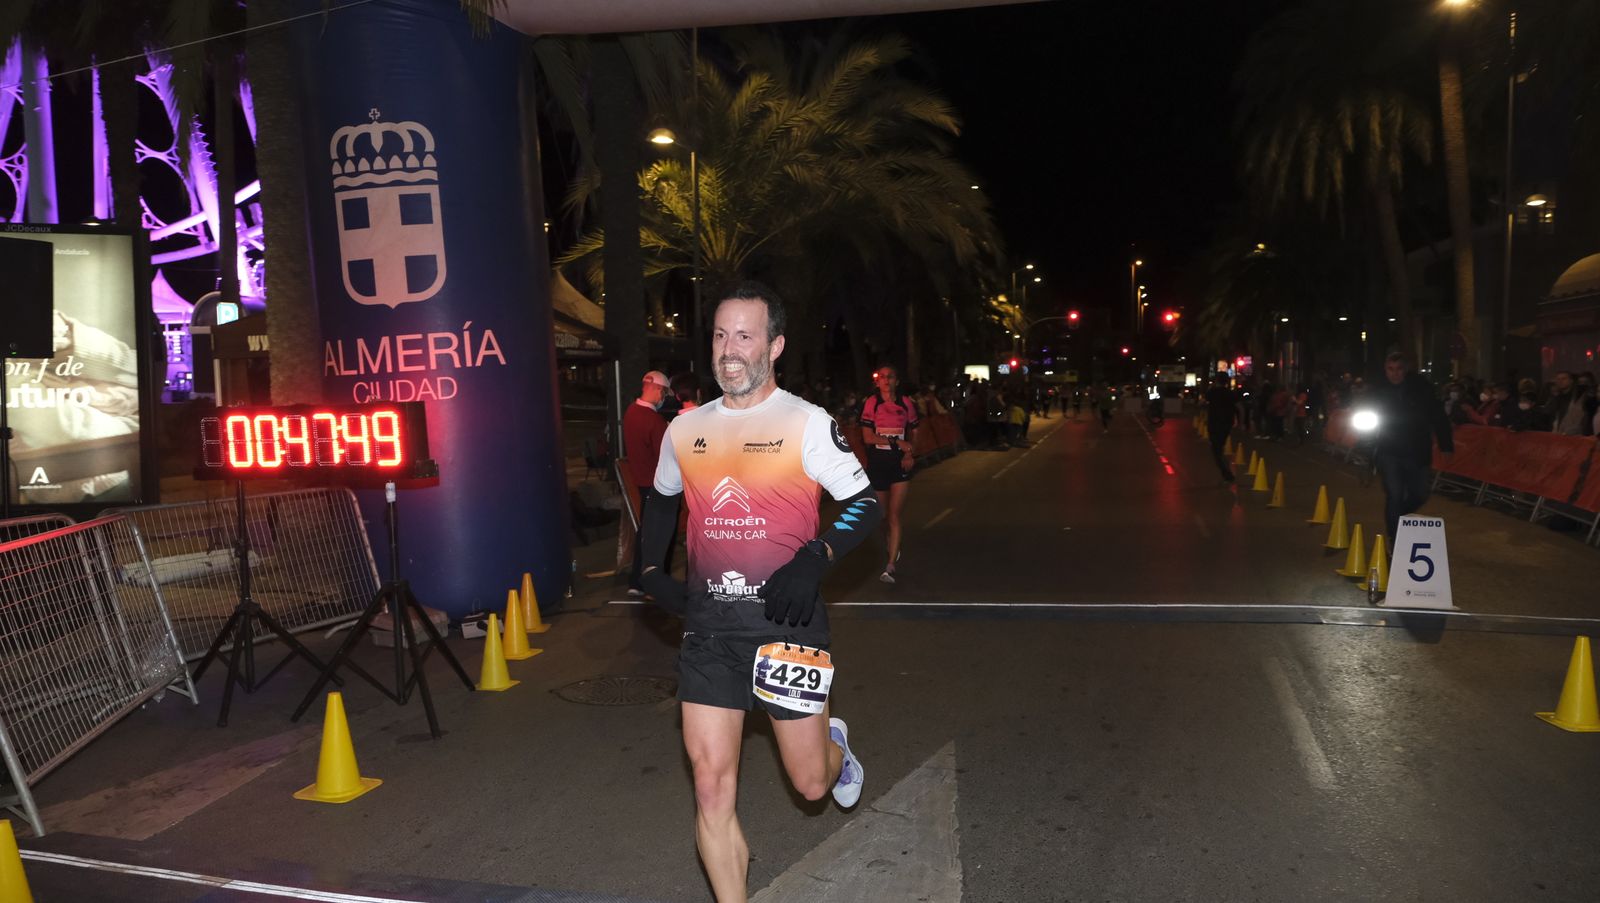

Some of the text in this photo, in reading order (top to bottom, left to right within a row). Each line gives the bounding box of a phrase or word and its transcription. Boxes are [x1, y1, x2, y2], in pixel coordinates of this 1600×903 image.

[4, 224, 52, 233] JCDecaux
[325, 320, 507, 377] ALMERÍA
[55, 356, 84, 376] de
[353, 376, 458, 404] CIUDAD
[226, 411, 402, 468] 00:47:49
[704, 516, 766, 527] CITROËN
[1402, 520, 1442, 528] MONDO
[704, 530, 767, 540] SALINAS CAR
[1407, 543, 1435, 583] 5
[770, 663, 822, 691] 429
[788, 688, 801, 698] LOLO
